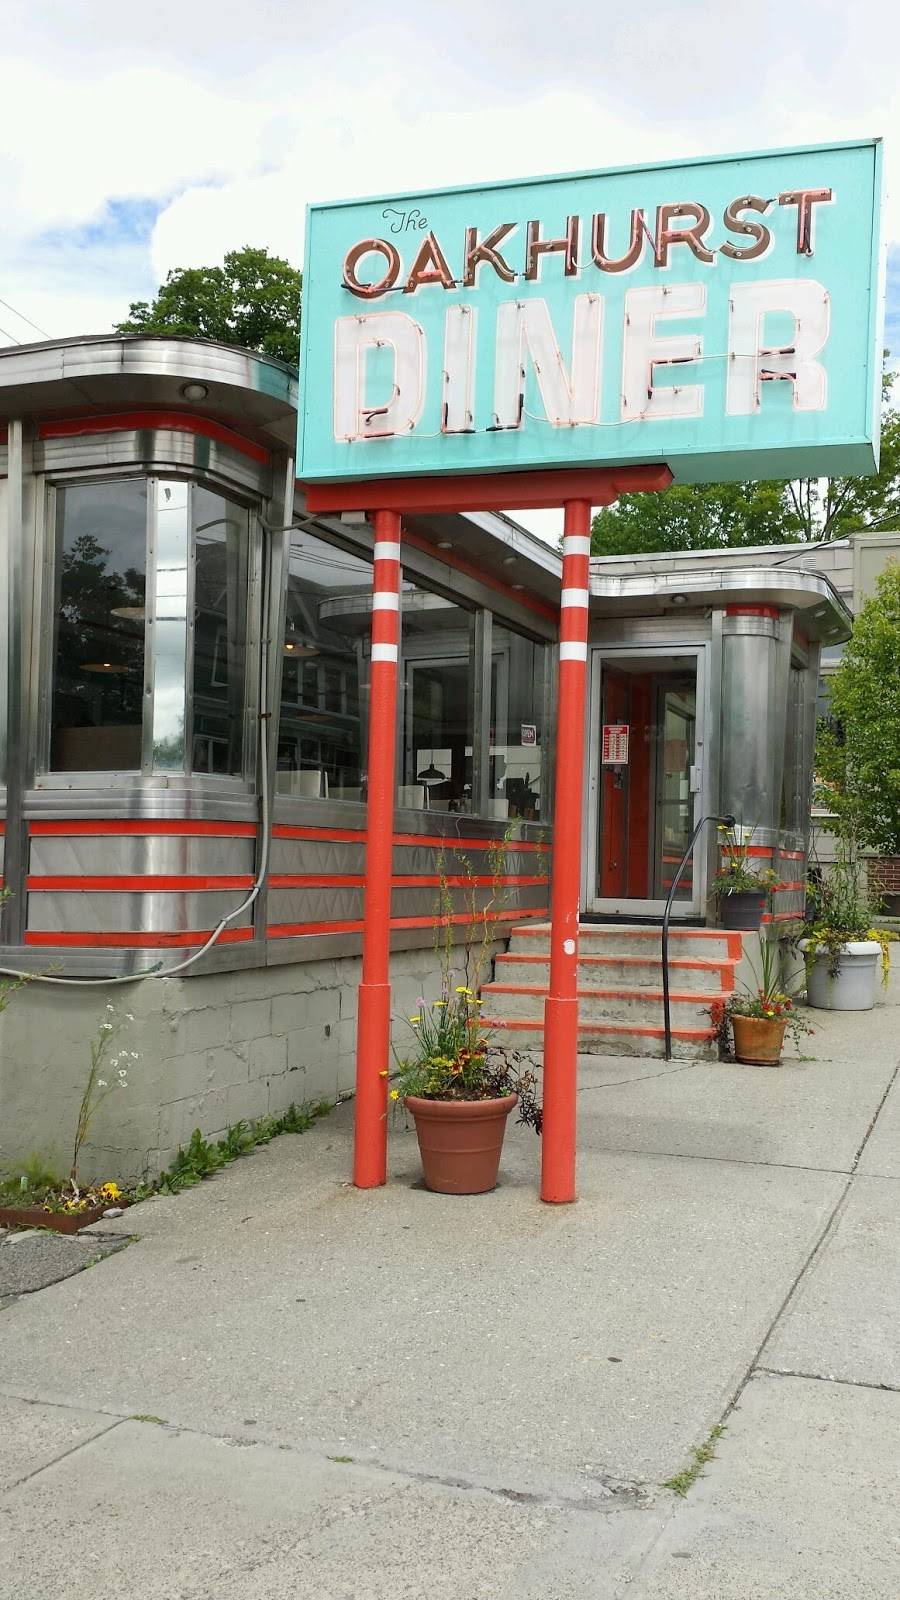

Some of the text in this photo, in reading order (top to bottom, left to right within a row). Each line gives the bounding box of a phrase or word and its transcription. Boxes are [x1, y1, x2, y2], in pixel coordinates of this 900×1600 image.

[342, 188, 833, 299] OAKHURST
[382, 208, 428, 233] The
[334, 279, 831, 442] DINER
[521, 728, 534, 738] OPEN
